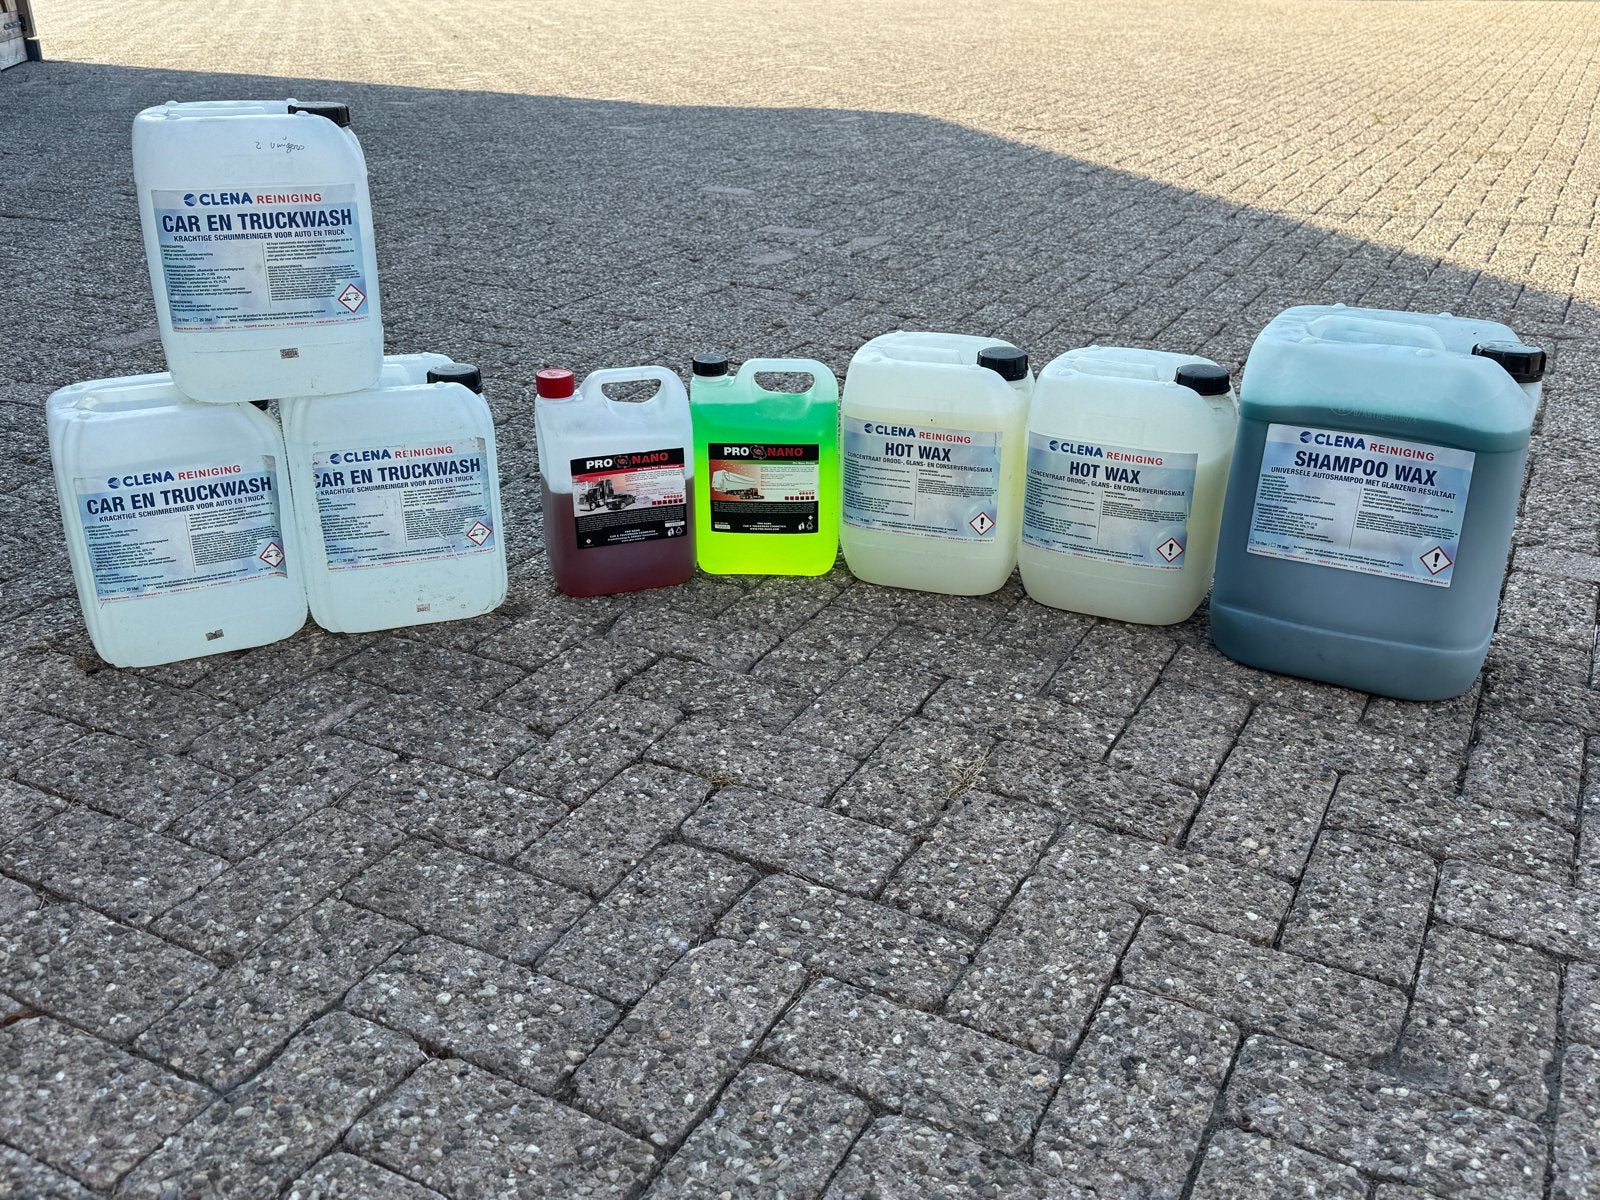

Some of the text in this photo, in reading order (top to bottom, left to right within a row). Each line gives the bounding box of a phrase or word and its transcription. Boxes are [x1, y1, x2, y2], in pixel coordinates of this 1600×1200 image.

[200, 192, 321, 206] CLENA REINIGING
[162, 209, 352, 233] CAR EN TRUCKWASH
[214, 233, 272, 241] SCHUIMREINIGER
[876, 425, 971, 443] CLENA REINIGING
[344, 446, 453, 462] CLENA REINIGING
[724, 447, 803, 456] PRO NANO
[885, 443, 951, 462] HOT WAX
[1061, 442, 1163, 466] CLENA REINIGING
[1314, 433, 1435, 461] CLENA REINIGING
[350, 469, 372, 484] EN
[378, 458, 480, 482] TRUCKWASH
[586, 453, 668, 469] PRO NANO
[848, 452, 881, 462] CONCENTRAAT
[936, 463, 992, 473] CONSERVERINGSWAX
[1294, 450, 1438, 486] SHAMPOO WAX
[123, 465, 241, 488] CLENA REINIGING
[1031, 468, 1065, 481] CONCENTRAAT
[1123, 484, 1185, 497] CONSERVERINGSWAX
[1070, 461, 1141, 484] HOT WAX
[1271, 467, 1456, 499] UNIVERSELE AUTOSHAMPOO MET GLANZEND RESULTAAT
[87, 477, 272, 515] CAR EN TRUCKWASH
[321, 487, 355, 496] KRACHTIGE
[357, 482, 408, 492] SCHUIMREINIGER
[100, 512, 136, 522] KRACHTIGE
[139, 504, 195, 518] SCHUIMREINIGER
